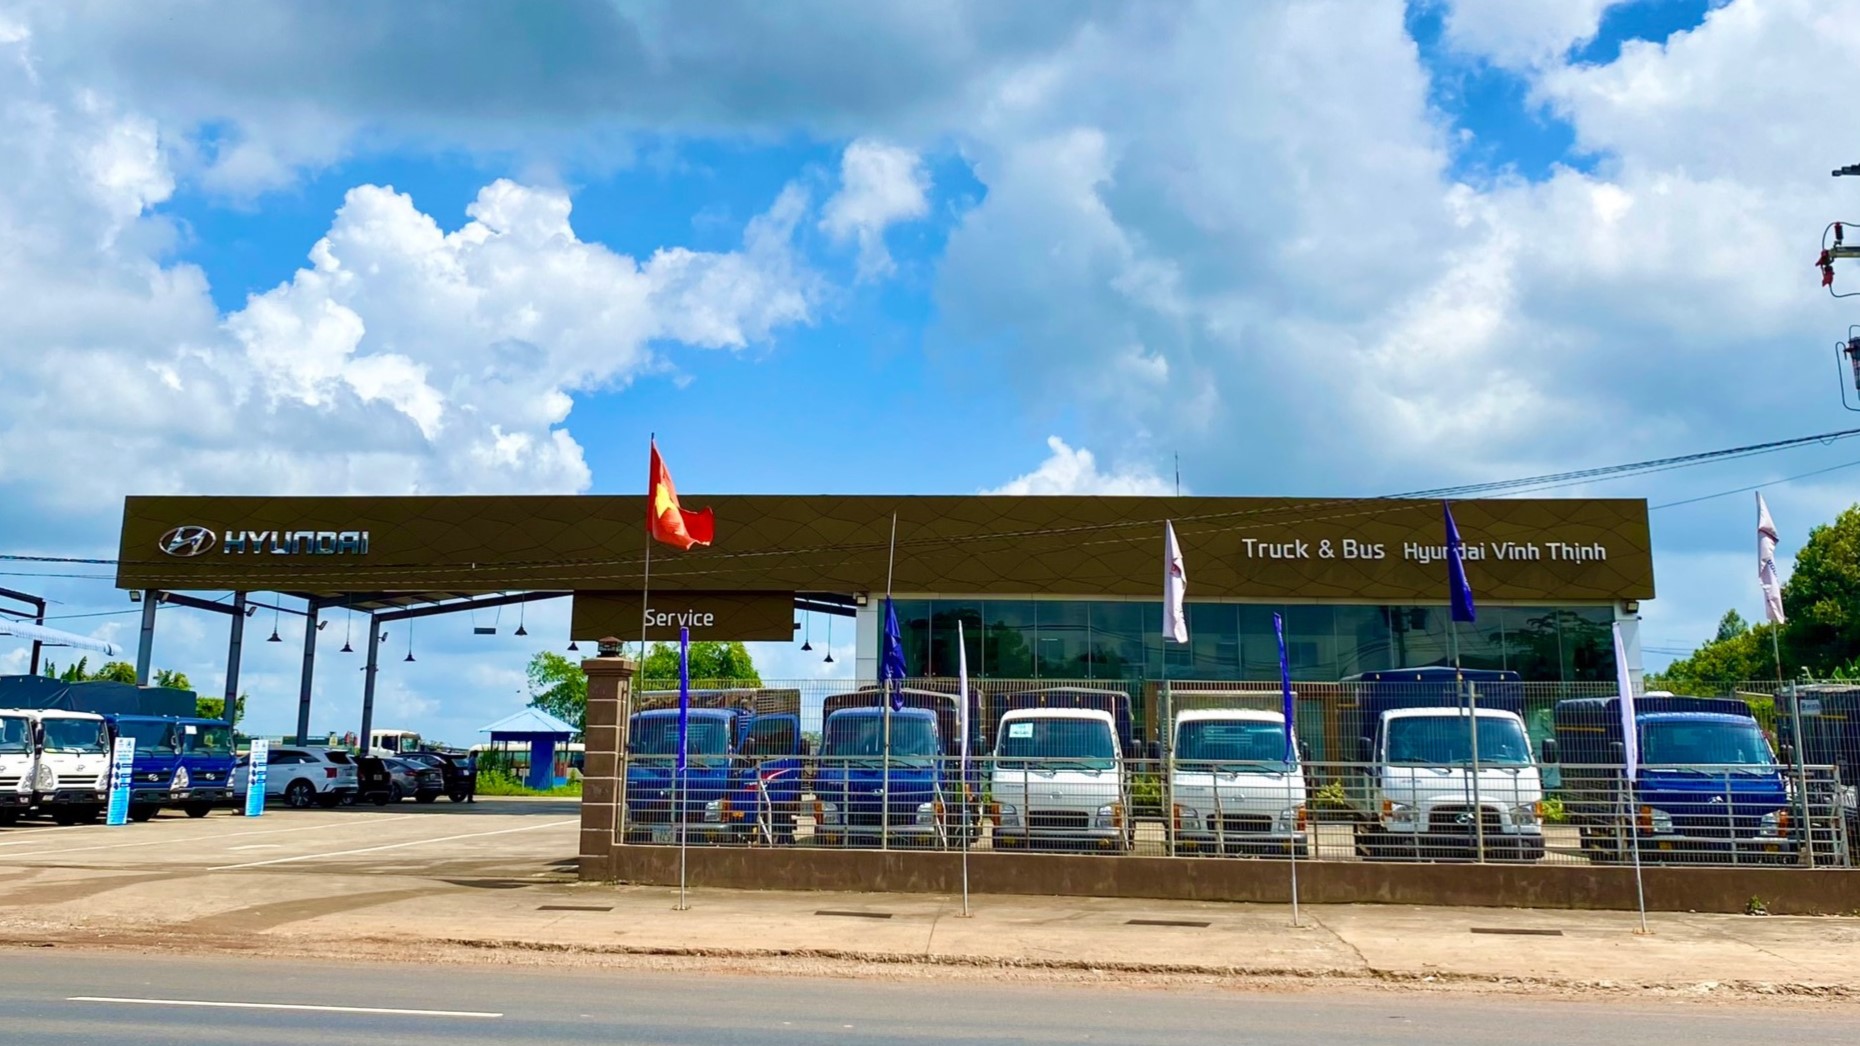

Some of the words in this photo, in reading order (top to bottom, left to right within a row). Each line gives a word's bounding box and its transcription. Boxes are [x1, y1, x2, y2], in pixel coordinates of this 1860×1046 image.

[223, 530, 370, 555] HYUNDAI
[1241, 538, 1310, 560] Truck
[1317, 539, 1336, 560] &
[1342, 538, 1386, 560] Bus
[1491, 541, 1541, 560] Vĩnh
[1545, 541, 1606, 565] Thịnh
[643, 608, 715, 627] Service
